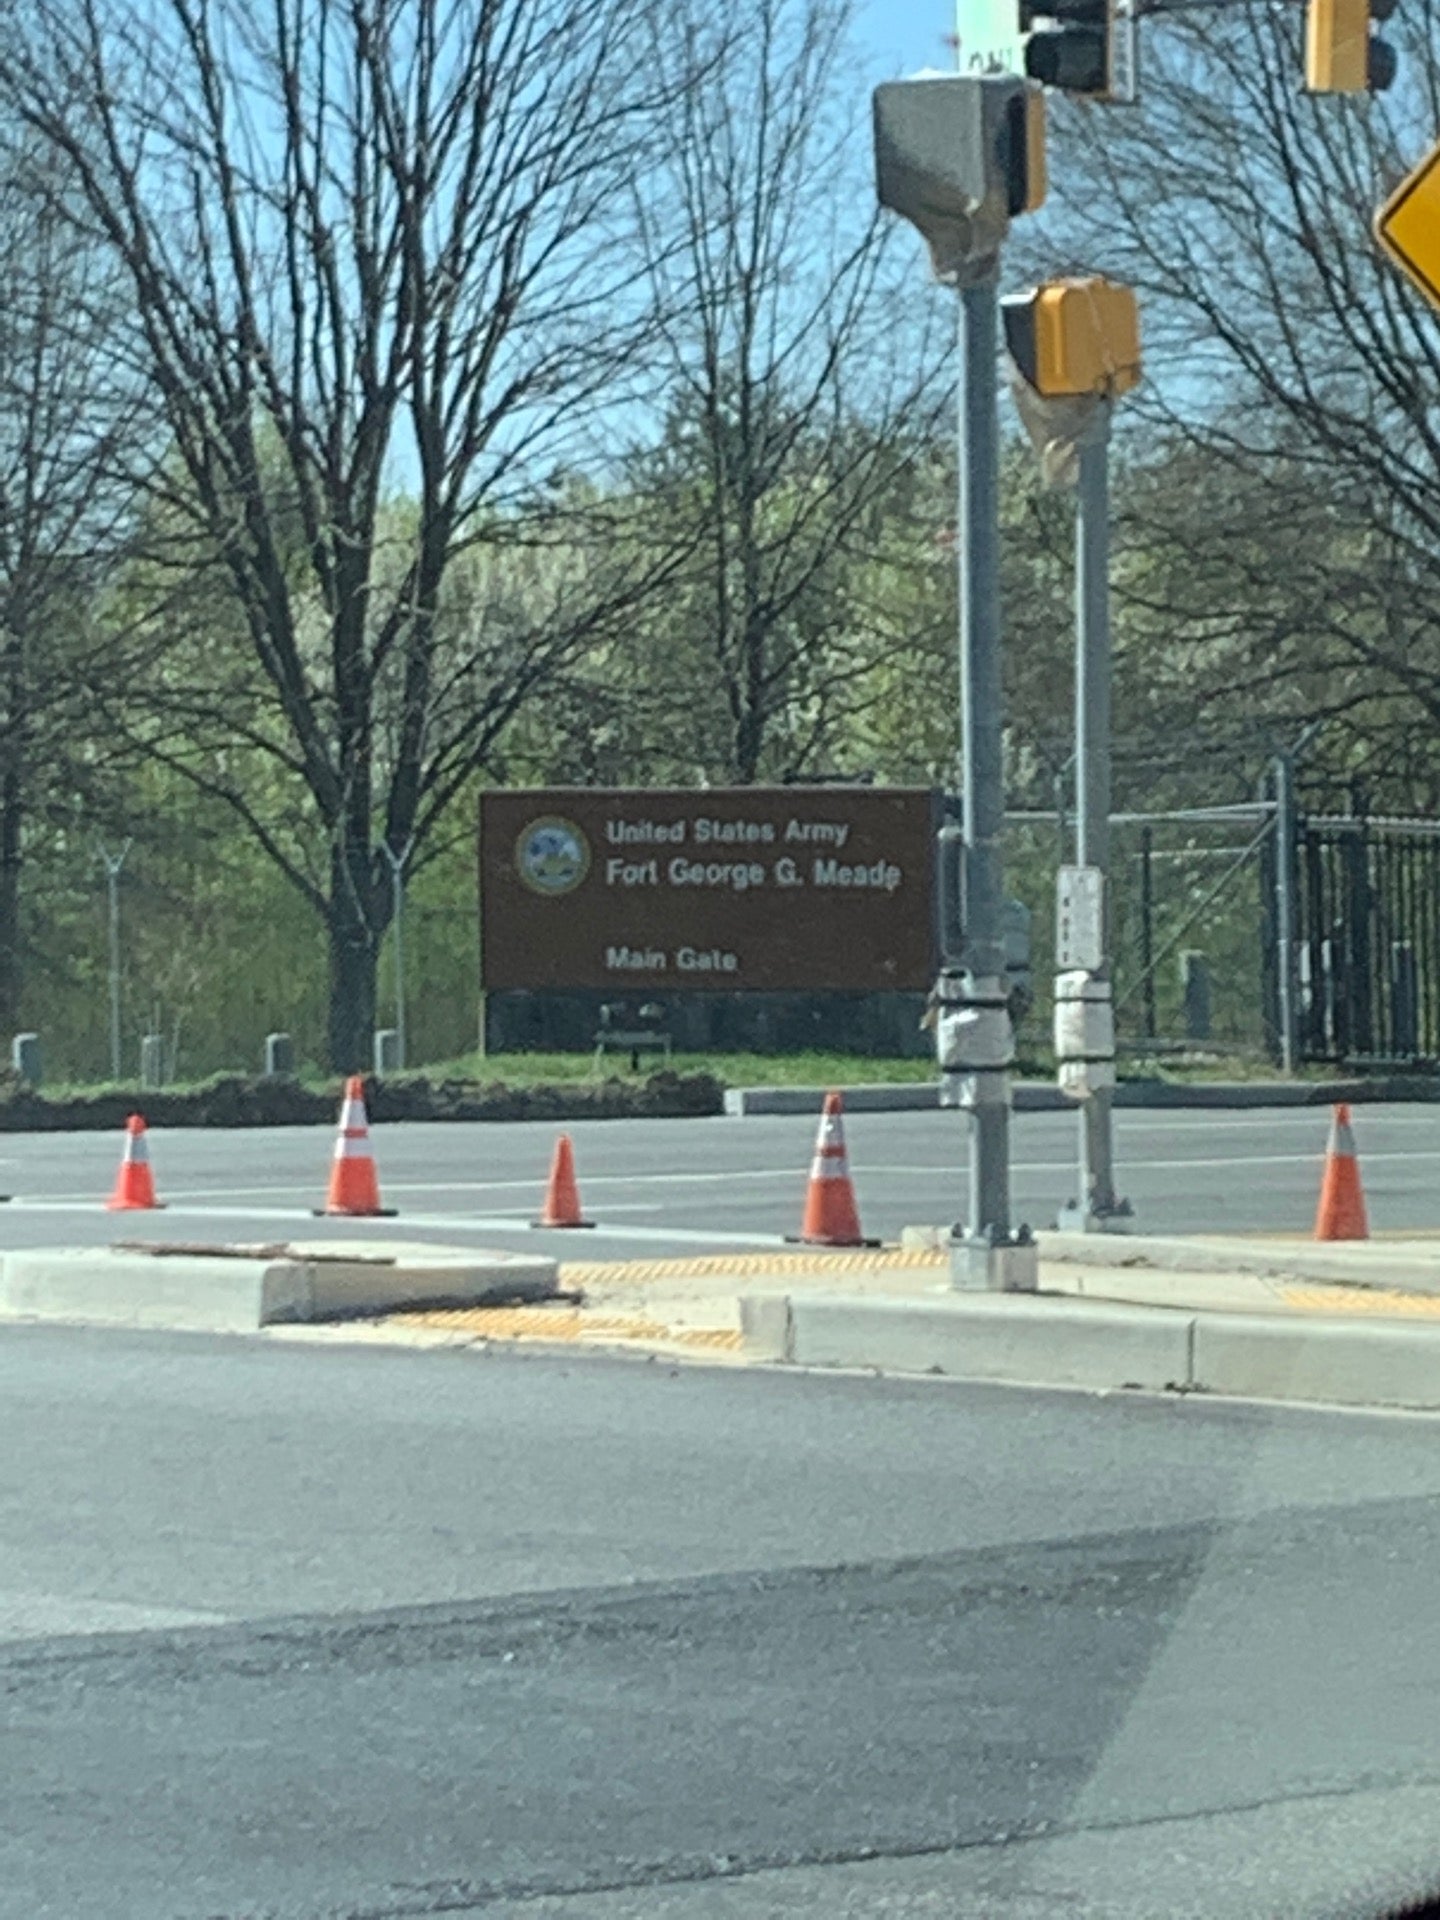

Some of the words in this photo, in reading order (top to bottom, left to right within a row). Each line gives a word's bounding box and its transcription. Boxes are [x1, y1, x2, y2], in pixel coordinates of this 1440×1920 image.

[606, 819, 686, 843] United
[694, 818, 775, 843] States
[785, 818, 849, 847] Army
[606, 858, 659, 886] Fort
[668, 857, 765, 890] George
[774, 856, 804, 886] G.
[814, 858, 901, 887] Meade
[606, 946, 667, 969] Main
[676, 946, 738, 971] Gate
